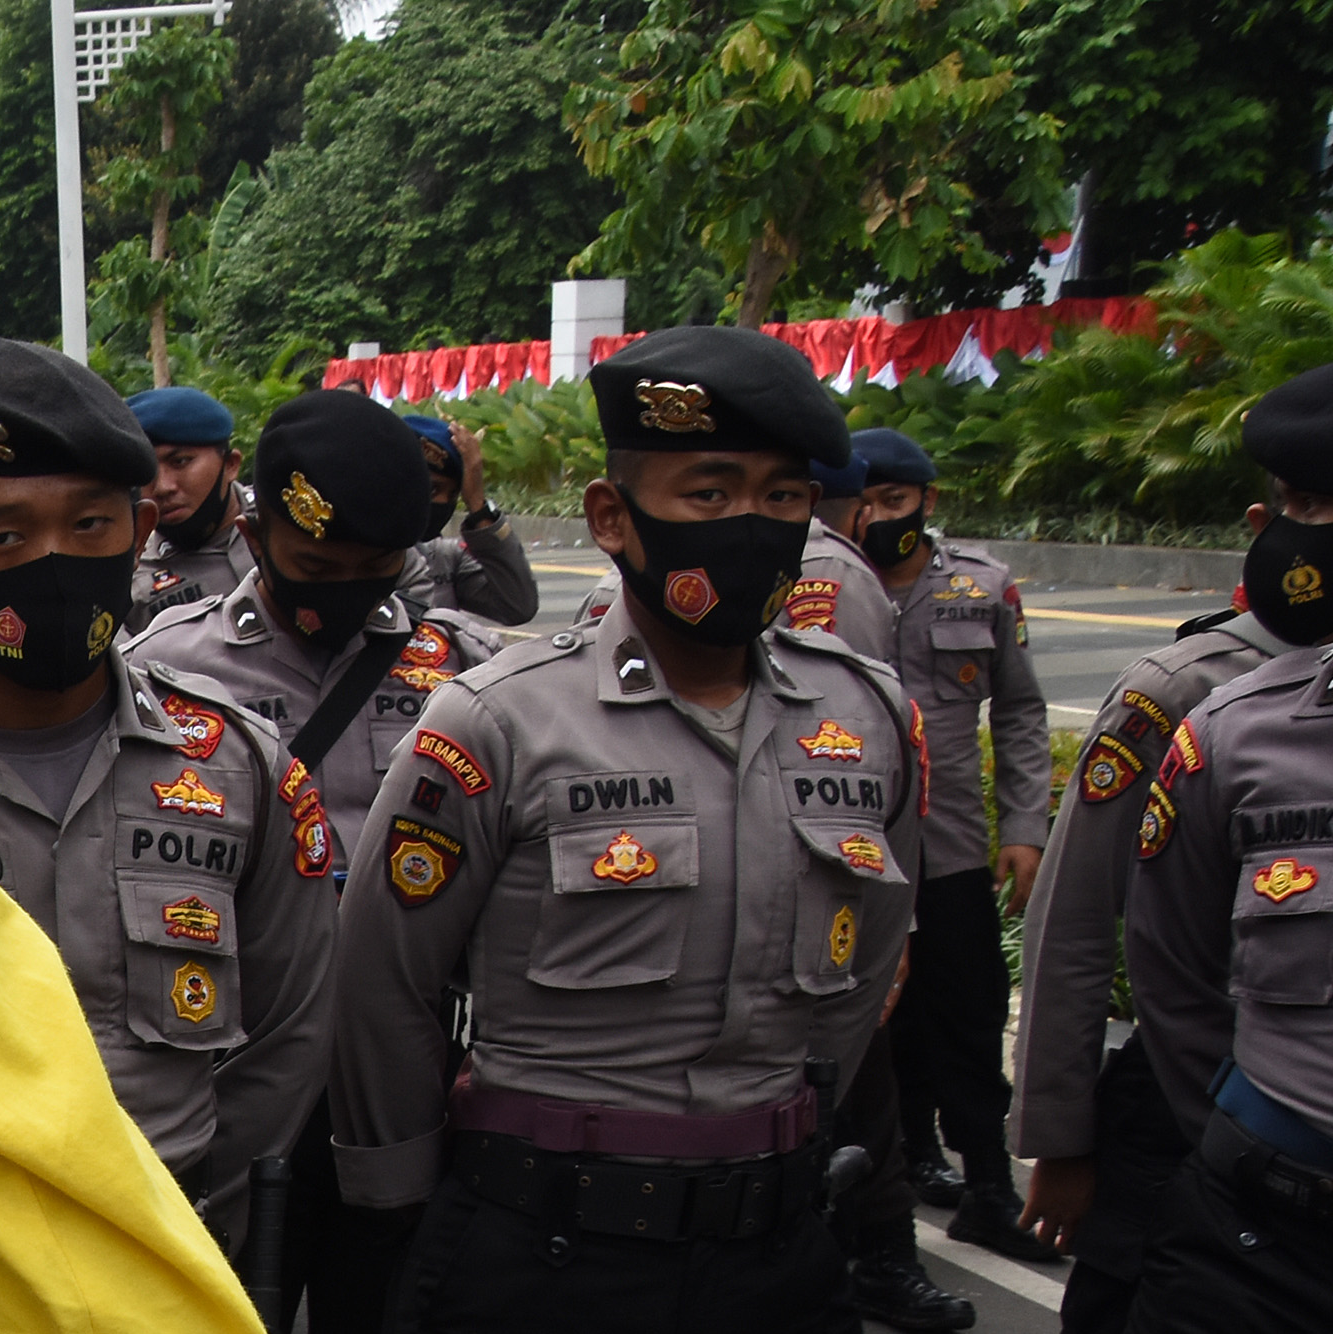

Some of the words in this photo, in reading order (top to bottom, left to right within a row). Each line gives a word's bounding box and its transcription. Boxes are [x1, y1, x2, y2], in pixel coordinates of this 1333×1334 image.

[1288, 588, 1324, 606] POLRI
[375, 694, 425, 717] PO
[420, 735, 435, 752] DIT
[434, 740, 483, 789] SAMAPTA
[569, 776, 674, 813] DWI.N
[794, 777, 883, 811] POLRI
[132, 828, 238, 875] POLRI
